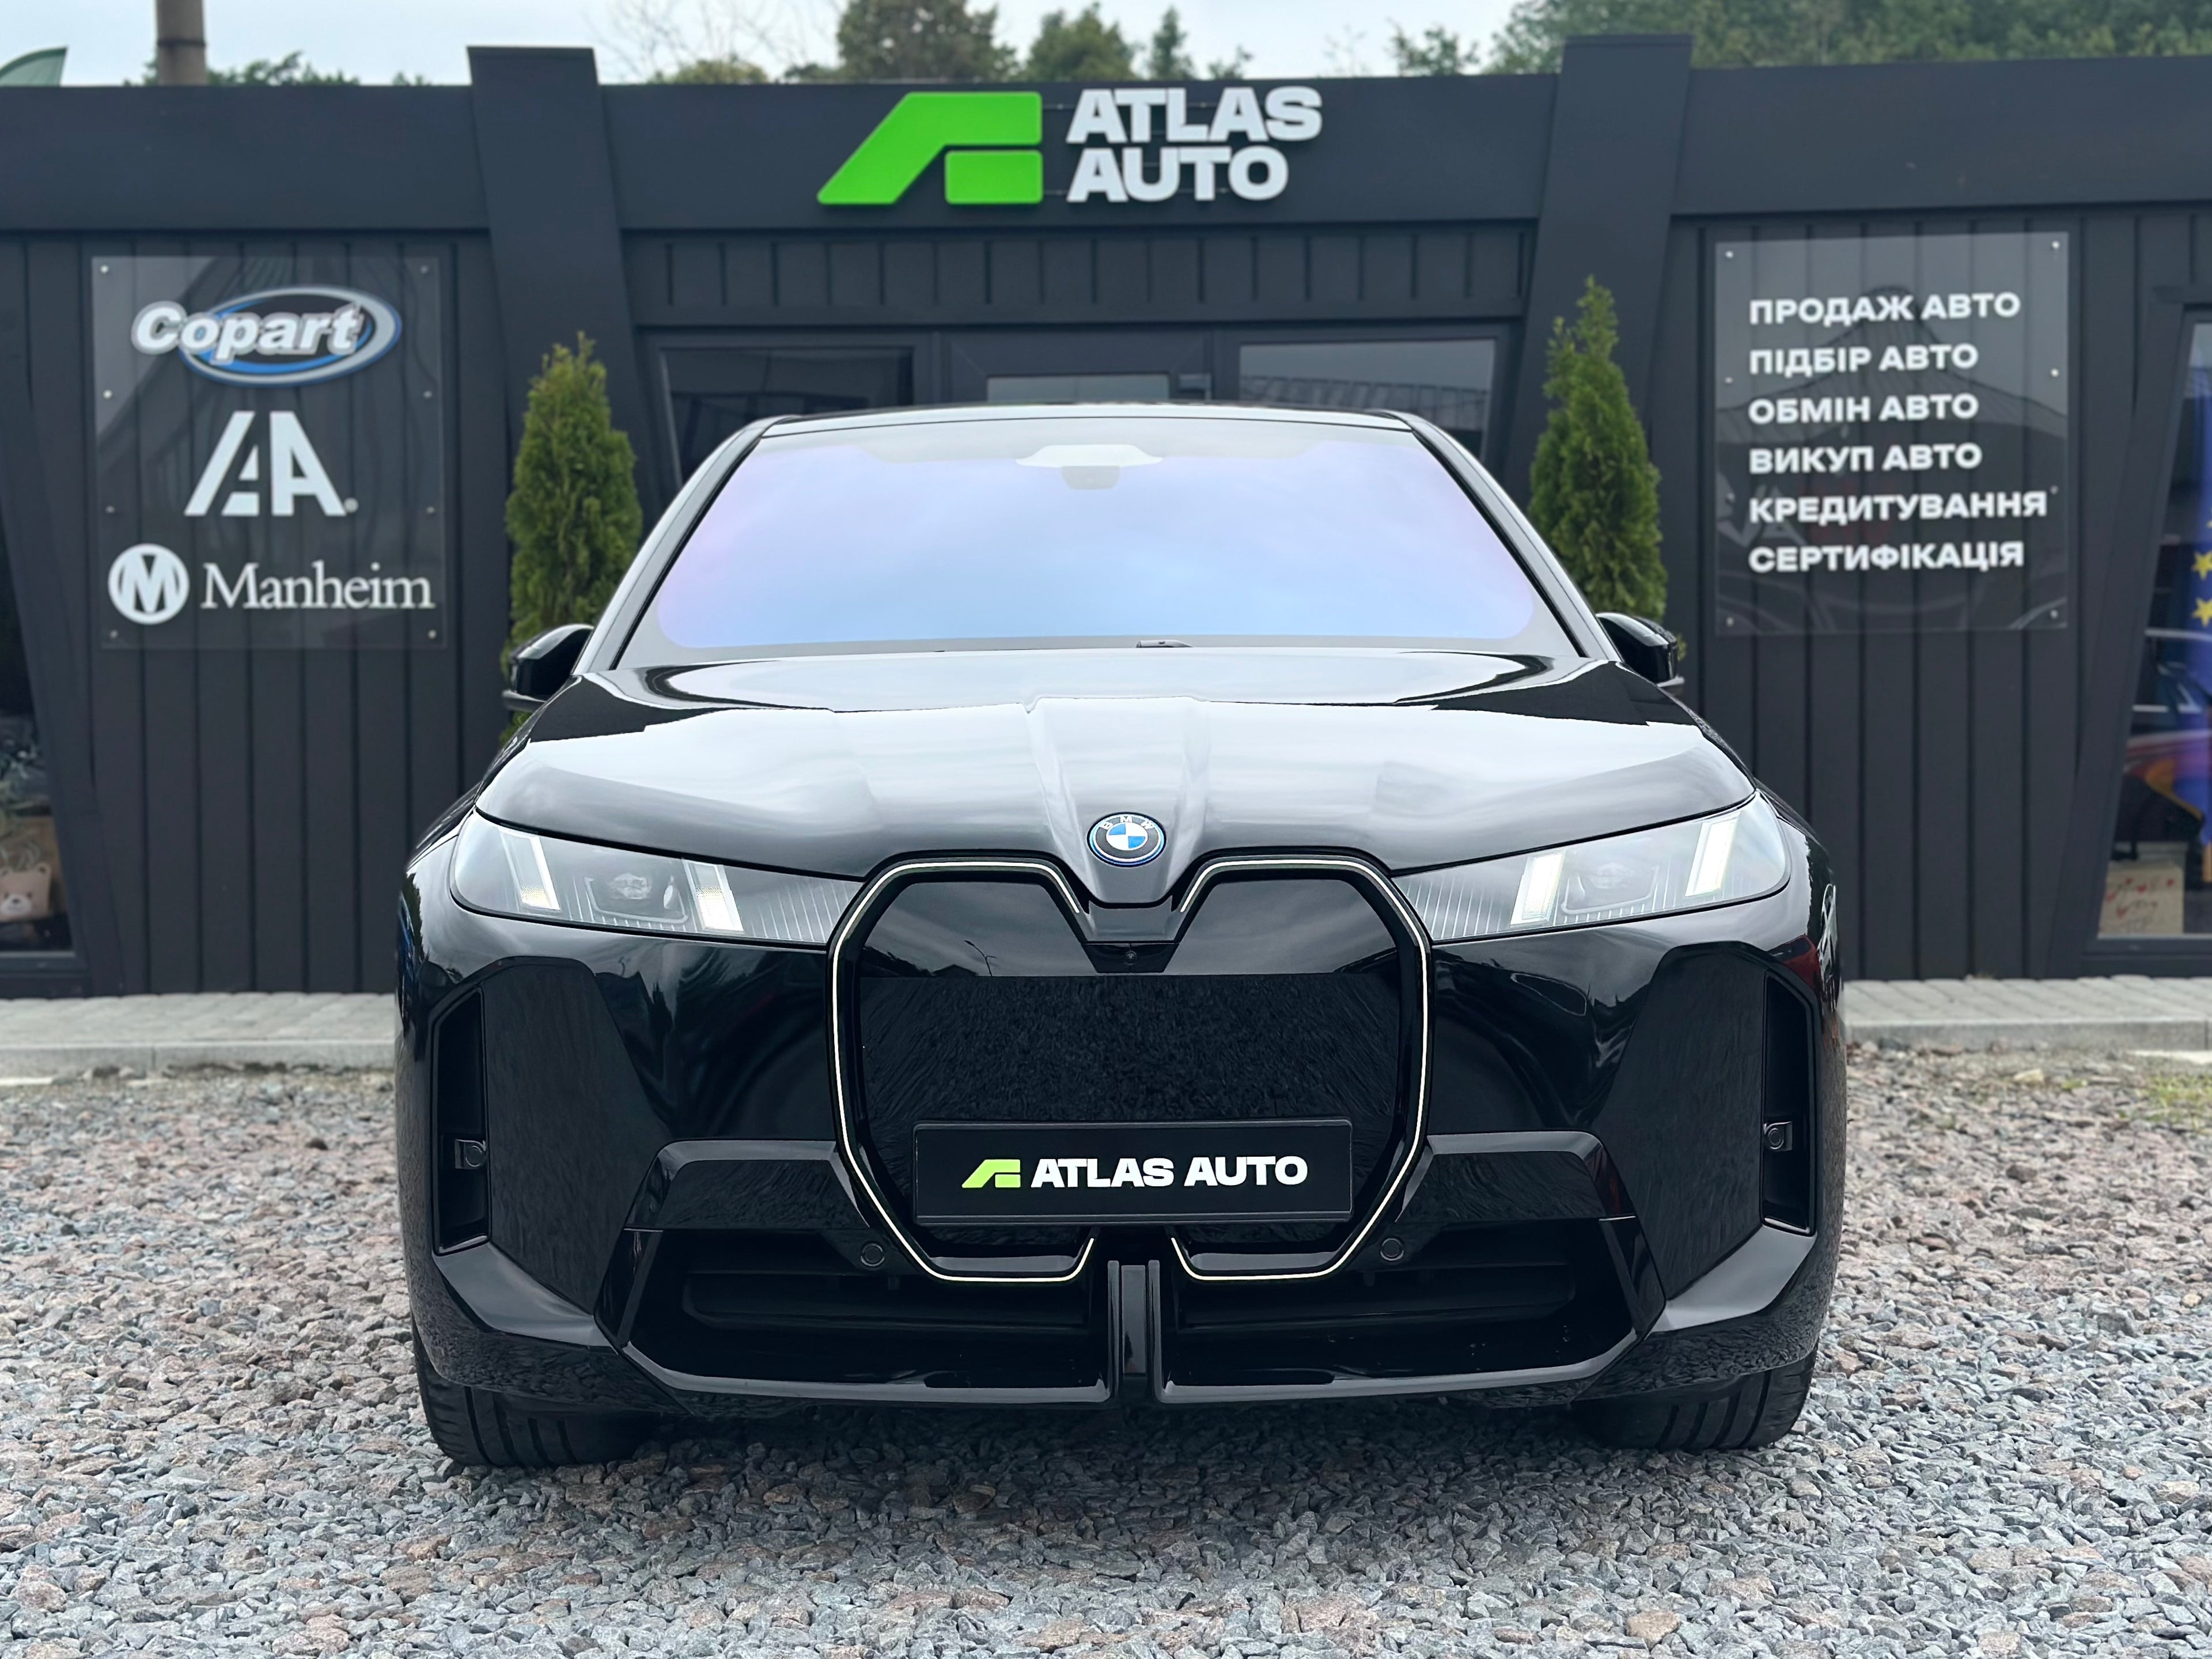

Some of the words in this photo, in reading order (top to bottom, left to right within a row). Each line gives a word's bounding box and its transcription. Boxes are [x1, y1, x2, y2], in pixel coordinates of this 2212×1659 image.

[1067, 86, 1322, 143] ATLAS
[1067, 146, 1289, 202] AUTO
[1749, 294, 1915, 327] ПРОДАЖ
[1921, 291, 2021, 320] АВТО
[134, 304, 360, 362] Copart
[1749, 346, 1872, 379] ПІДБІР
[1878, 343, 1979, 372] АВТО
[1748, 396, 1871, 425] ОБМІН
[1878, 393, 1979, 422] АВТО
[1749, 446, 1874, 474] ВИКУП
[1882, 443, 1983, 471] АВТО
[1749, 491, 2047, 526] КРЕДИТУВАННЯ
[1749, 541, 2024, 573] СЕРТИФІКАЦІЯ
[200, 560, 435, 611] Manheim
[1100, 816, 1156, 830] BMW
[1031, 1157, 1175, 1188] ATLAS
[1184, 1155, 1308, 1187] AUTO
